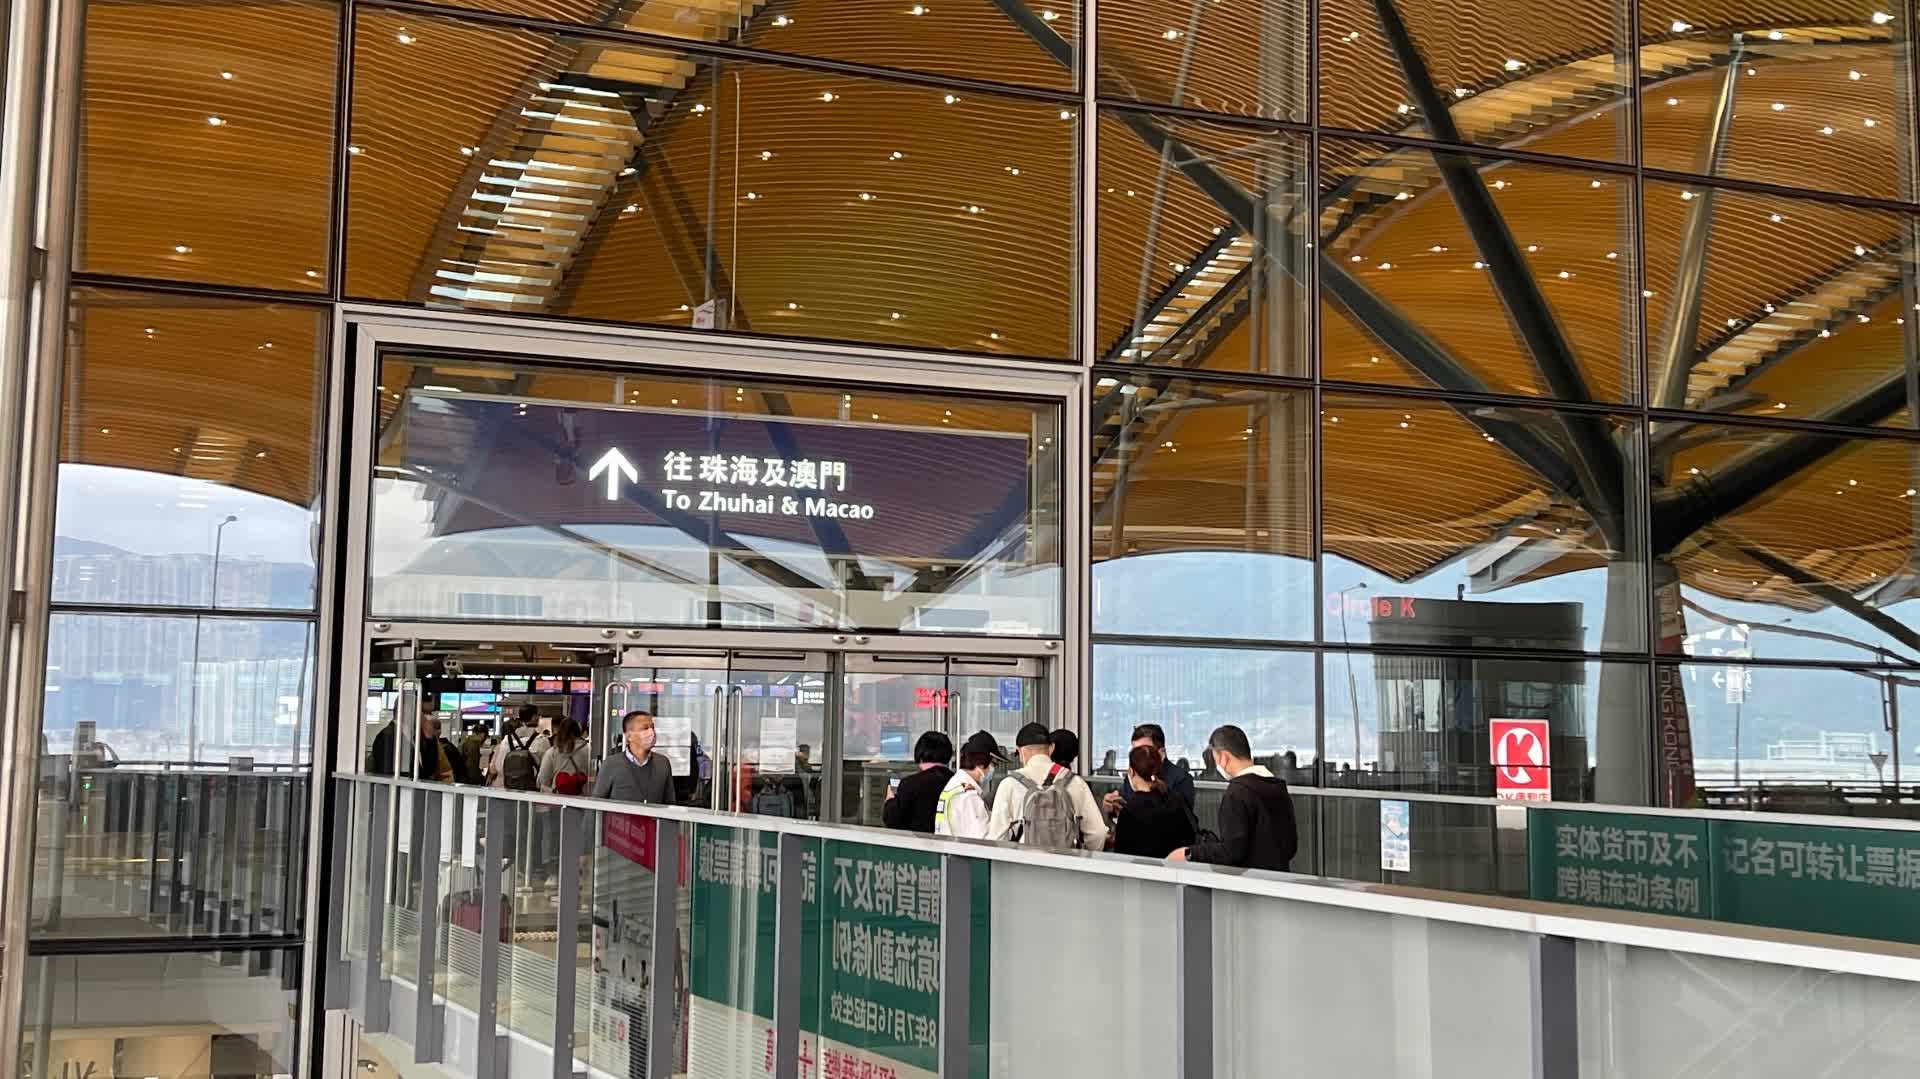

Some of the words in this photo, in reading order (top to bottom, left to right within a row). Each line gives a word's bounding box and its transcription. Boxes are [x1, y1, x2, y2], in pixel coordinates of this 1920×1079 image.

[661, 489, 692, 511] To
[697, 491, 774, 515] Zhuhai
[781, 495, 799, 516] &
[805, 498, 875, 519] Macao
[1400, 596, 1416, 618] K
[1556, 824, 1698, 868] 实体货币及不
[1556, 866, 1699, 913] 跨境流动条例
